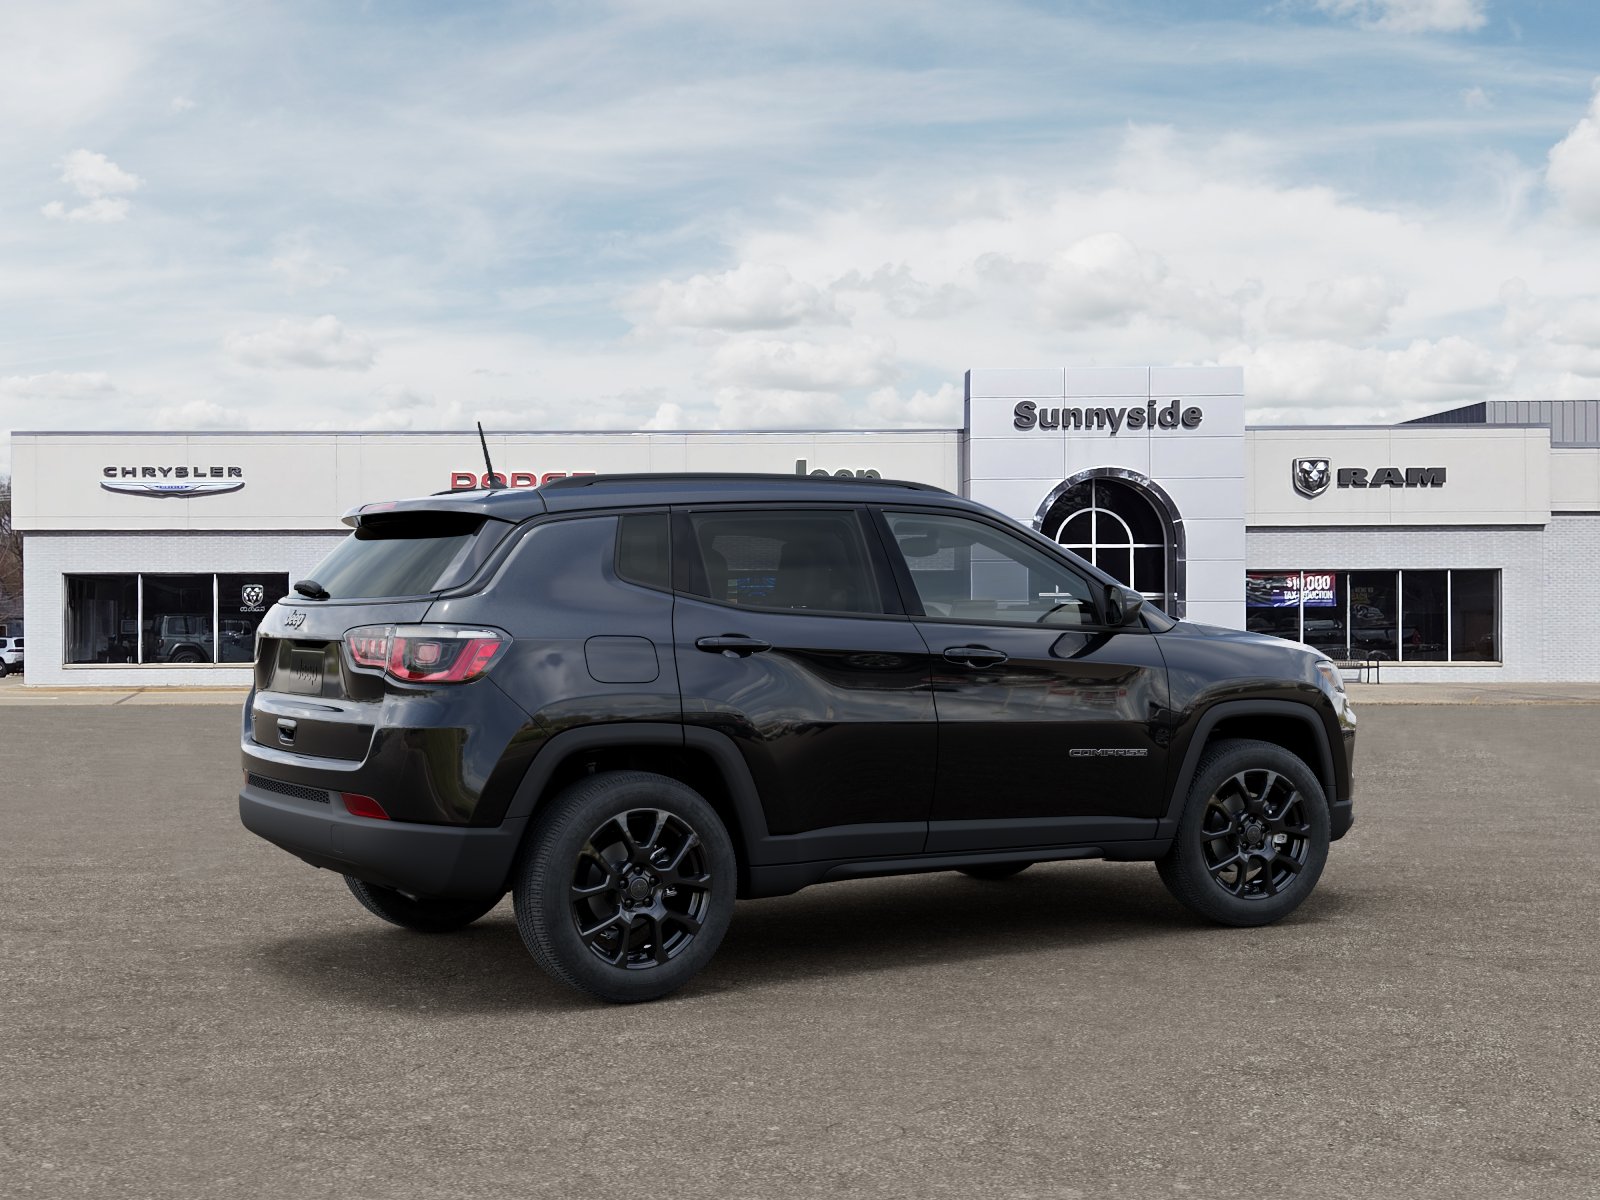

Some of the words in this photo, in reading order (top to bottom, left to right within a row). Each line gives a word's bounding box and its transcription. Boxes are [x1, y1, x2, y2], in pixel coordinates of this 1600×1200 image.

[1014, 400, 1203, 436] Sunnyside
[103, 466, 243, 478] CHRYSLER
[1337, 467, 1447, 488] RAM
[1069, 748, 1148, 757] COMPASS
